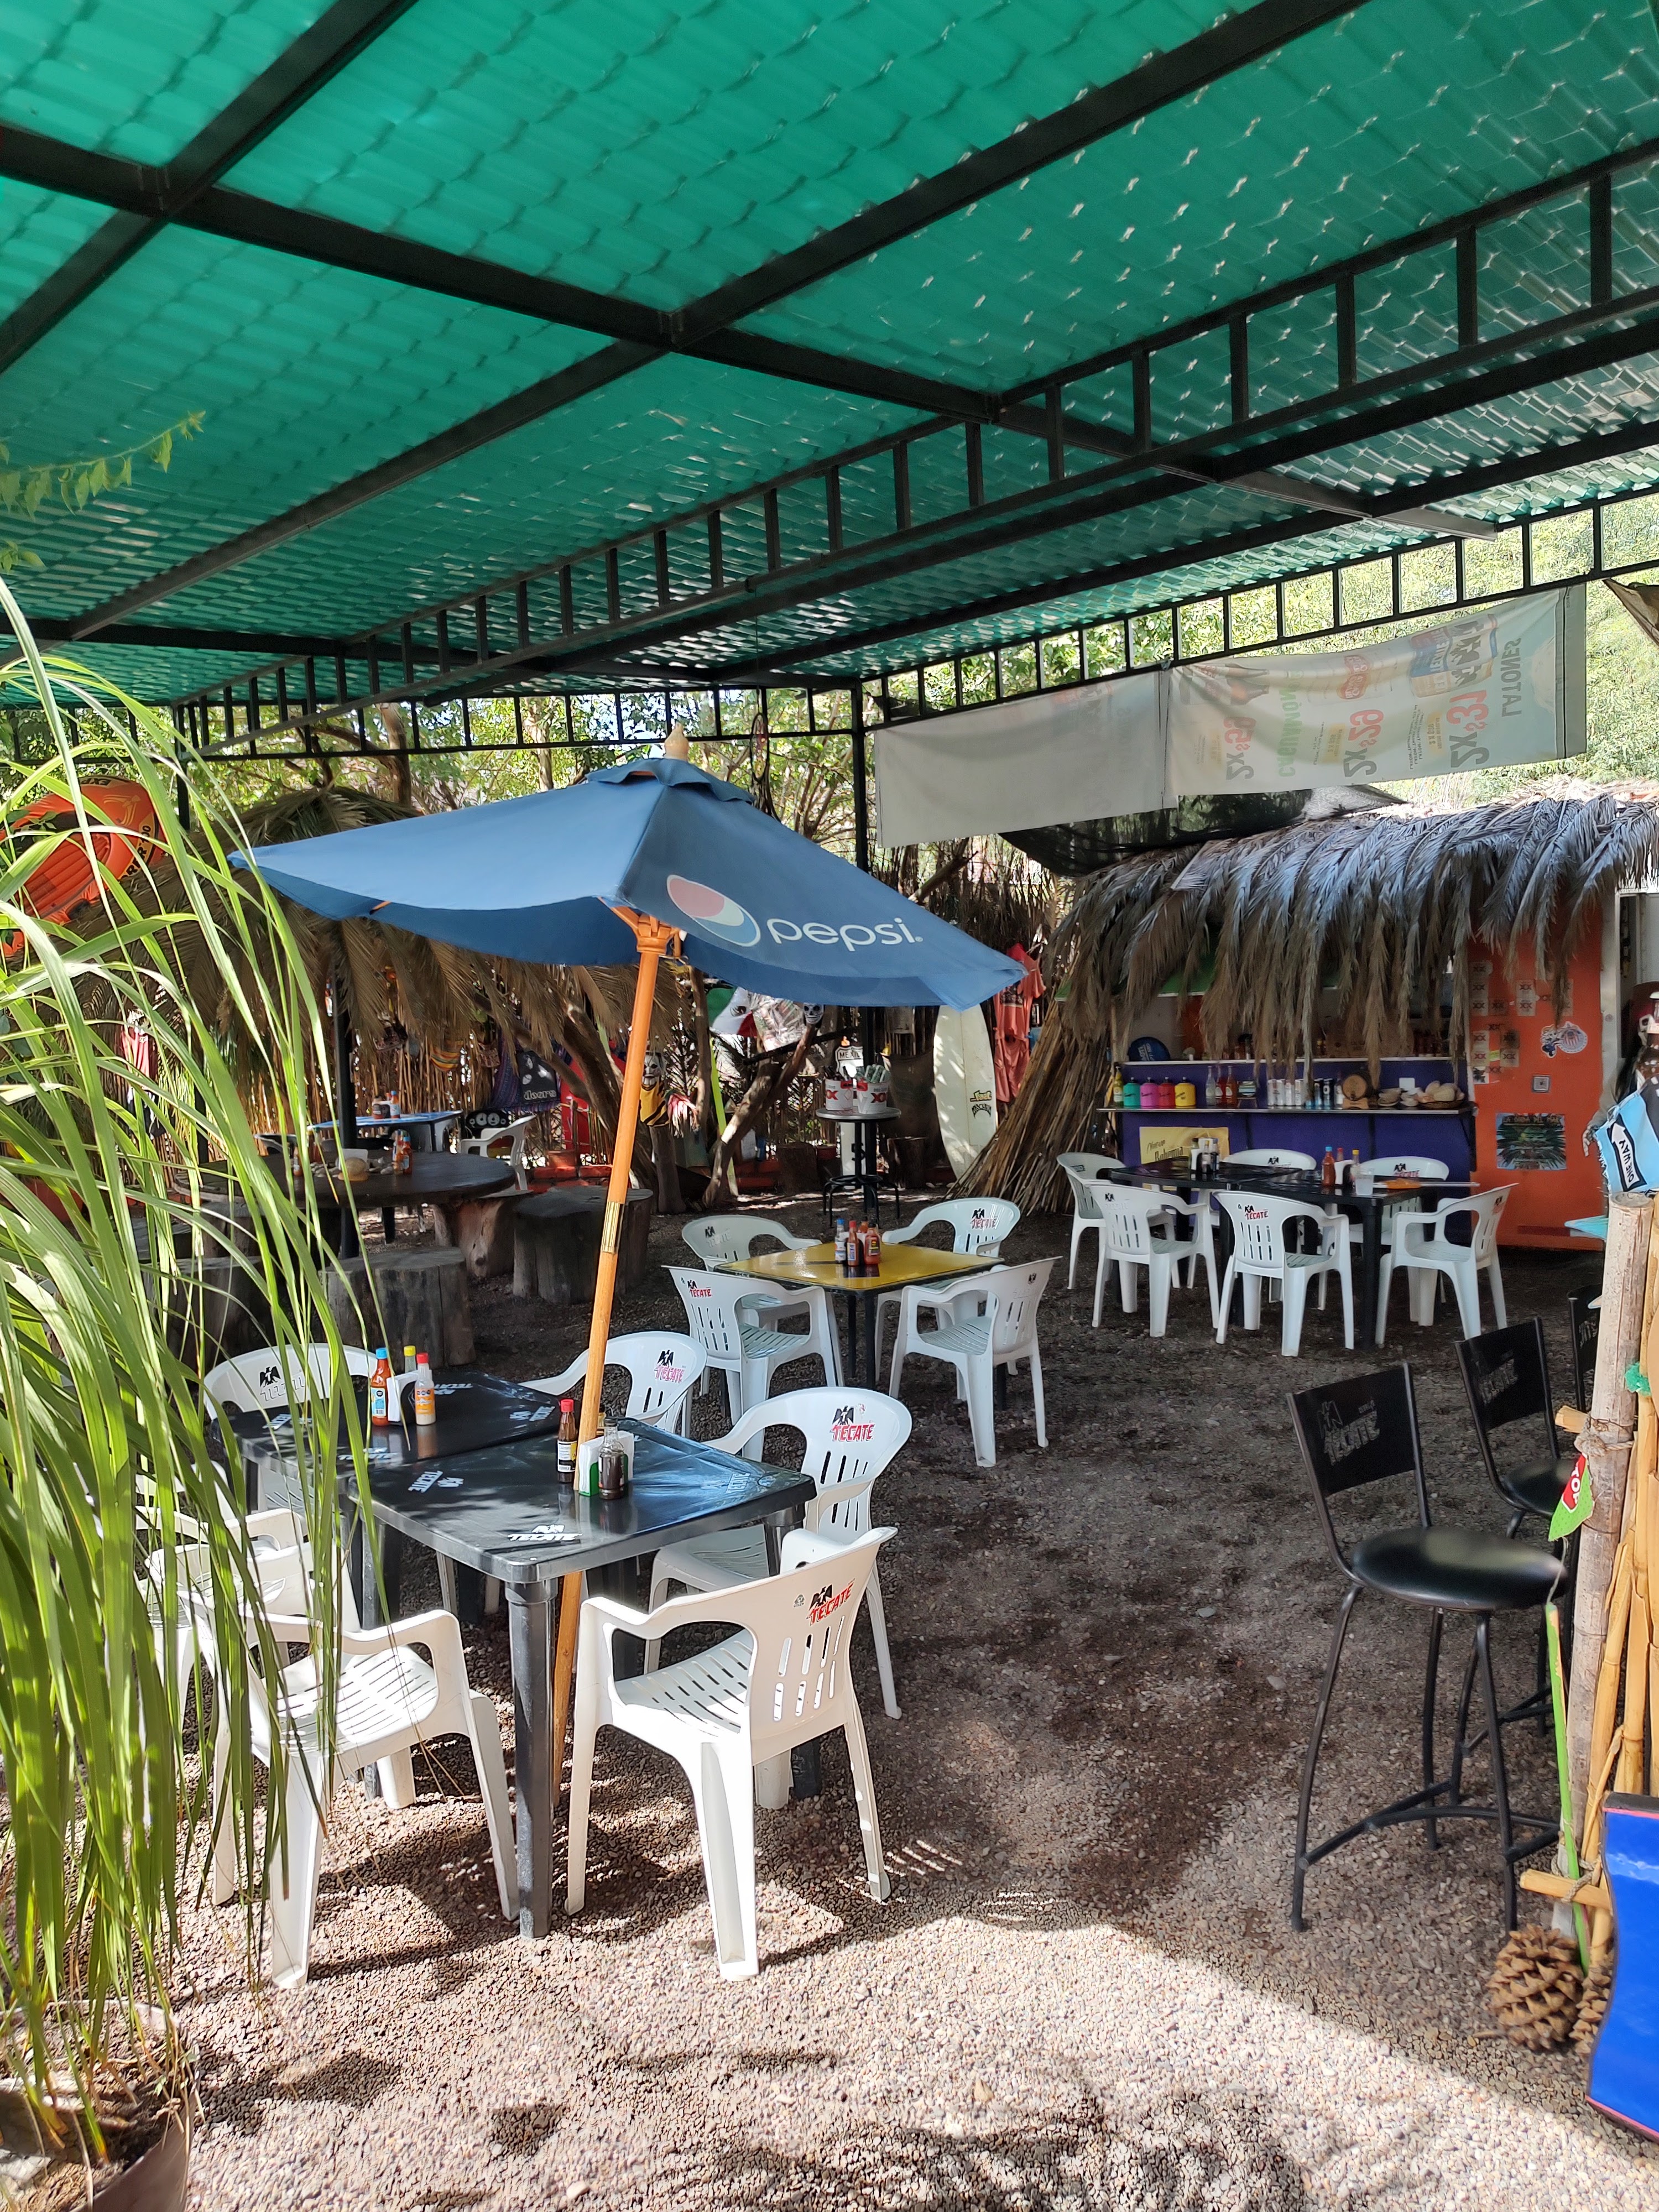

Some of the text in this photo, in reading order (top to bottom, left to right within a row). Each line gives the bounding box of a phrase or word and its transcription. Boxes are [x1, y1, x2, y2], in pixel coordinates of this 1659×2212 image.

[766, 917, 915, 952] pepsi
[839, 1050, 863, 1059] MEXIC
[1619, 1139, 1631, 1165] WAY
[970, 1218, 998, 1229] TECATE
[1244, 1211, 1269, 1220] TECATE
[690, 1288, 712, 1298] TECATE
[654, 1365, 686, 1384] TECATE
[830, 1423, 875, 1442] TECATE
[408, 1470, 444, 1493] TECATE
[507, 1533, 583, 1542] TECATE
[806, 1582, 854, 1626] TECATE
